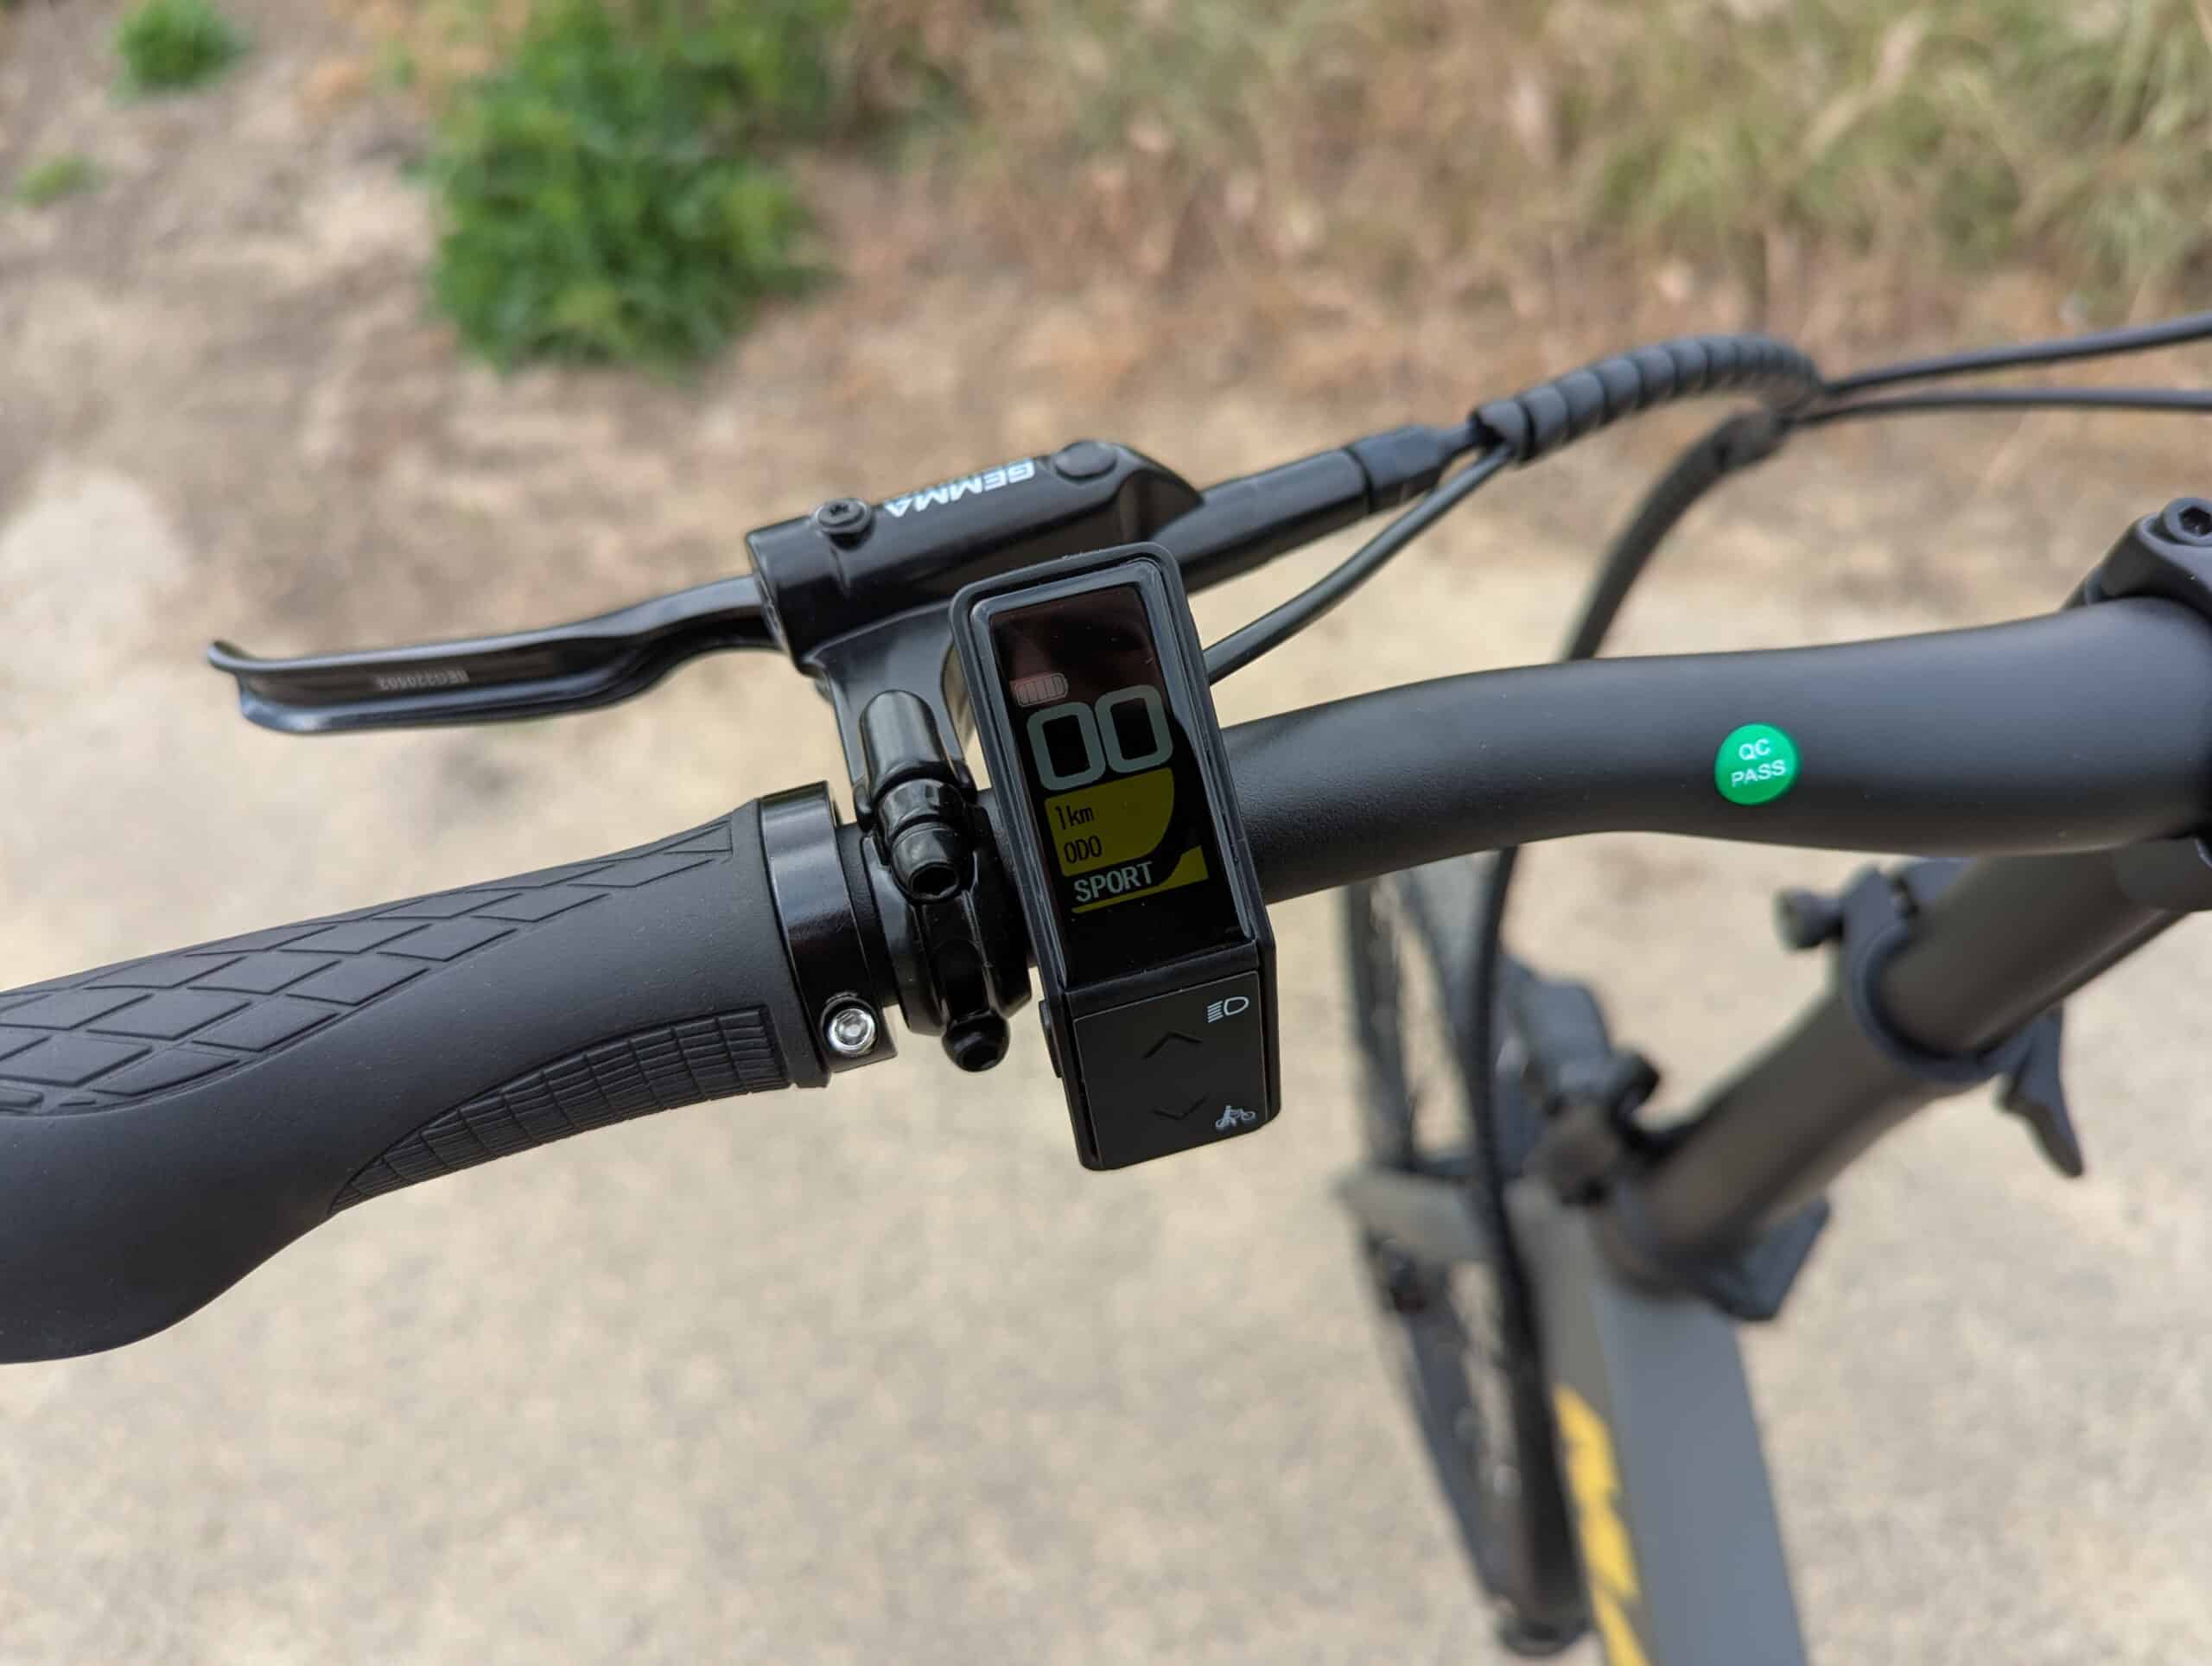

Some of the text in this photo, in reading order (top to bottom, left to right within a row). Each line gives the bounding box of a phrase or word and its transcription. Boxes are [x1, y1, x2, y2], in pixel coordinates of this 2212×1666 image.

[885, 458, 1037, 518] GEMMA
[1026, 684, 1173, 791] 00
[1738, 738, 1770, 760] QC
[1731, 760, 1785, 787] PASS
[1064, 835, 1102, 863] ODO
[1074, 861, 1153, 902] SPORT
